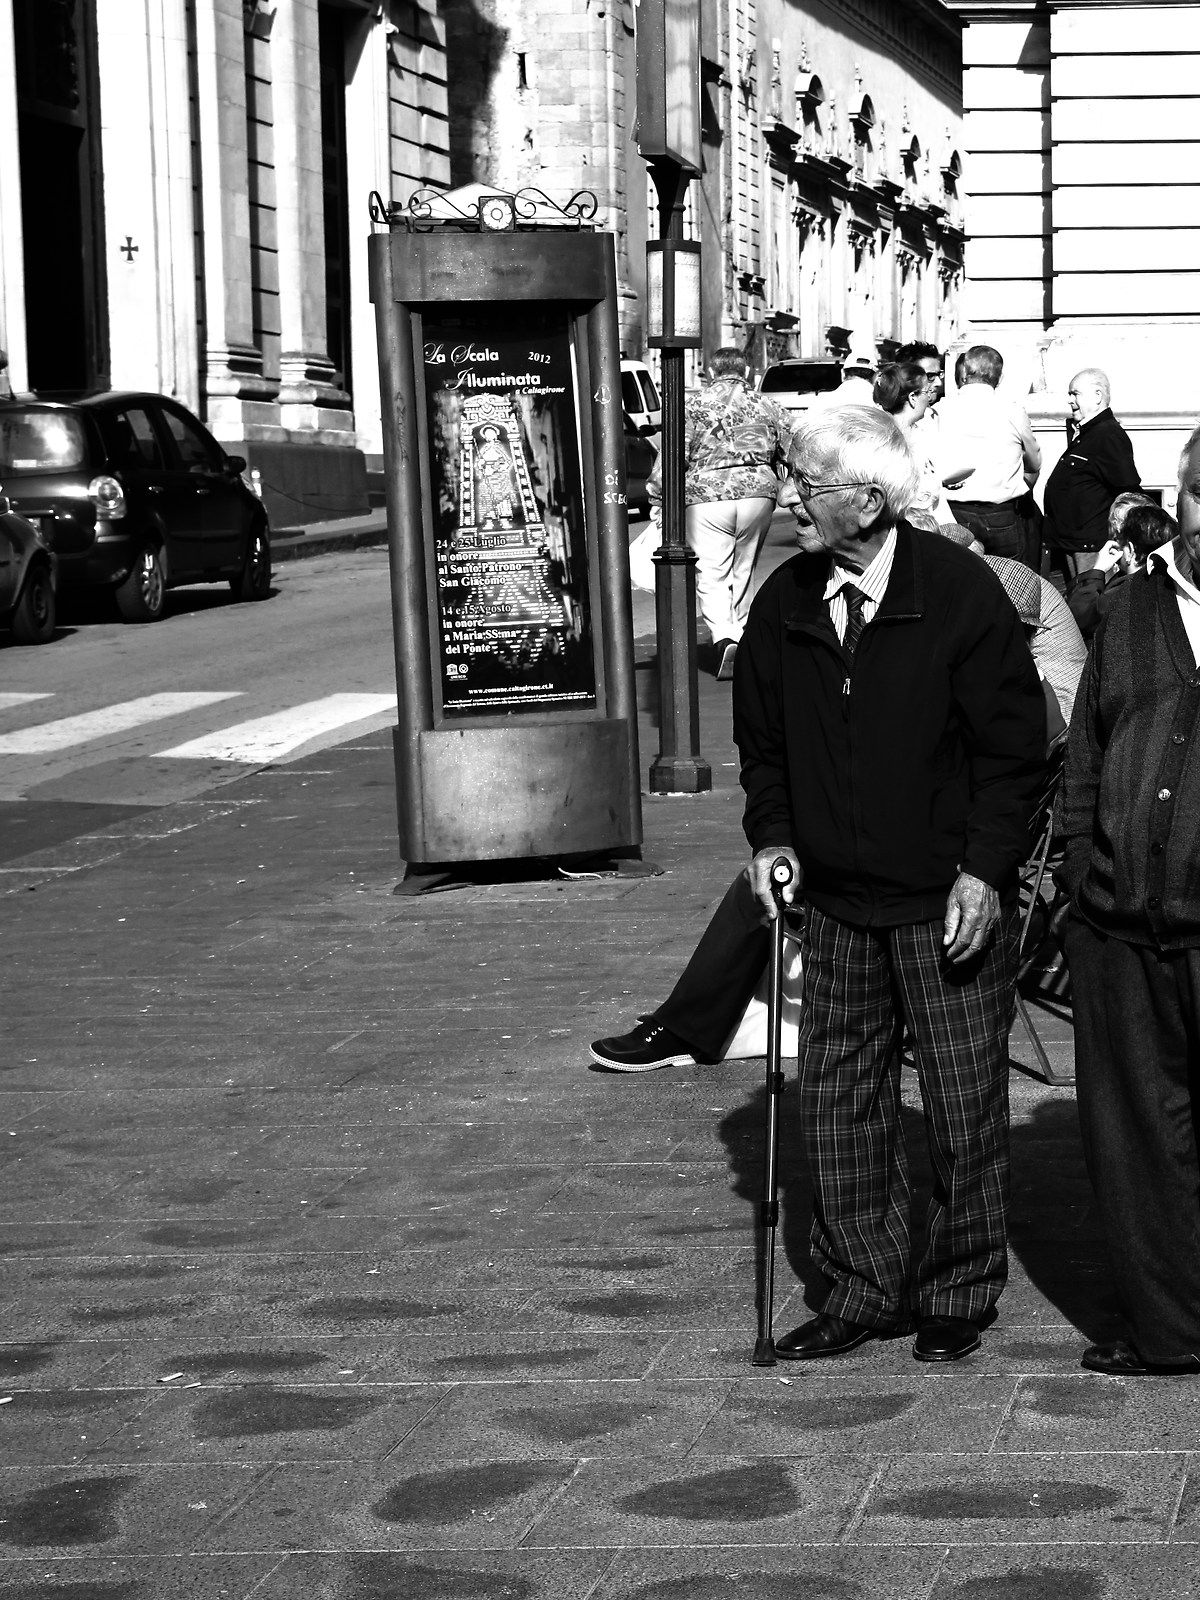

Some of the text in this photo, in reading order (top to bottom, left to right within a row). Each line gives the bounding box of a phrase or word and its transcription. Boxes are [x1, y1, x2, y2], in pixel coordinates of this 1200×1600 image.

[424, 343, 499, 366] La Scala
[528, 352, 551, 364] 2012
[446, 367, 541, 390] Illuminata
[522, 385, 565, 395] Caltagirone
[436, 540, 448, 548] 24
[459, 538, 471, 547] 25
[474, 536, 506, 548] Luglio
[437, 552, 479, 561] in onore
[438, 562, 522, 574] al Santo Patrono
[440, 576, 506, 587] San Giacomo
[442, 606, 453, 615] 14
[479, 604, 511, 615] Agosto
[443, 619, 483, 628] in onore
[453, 630, 483, 640] Maria
[445, 644, 491, 654] del Ponte
